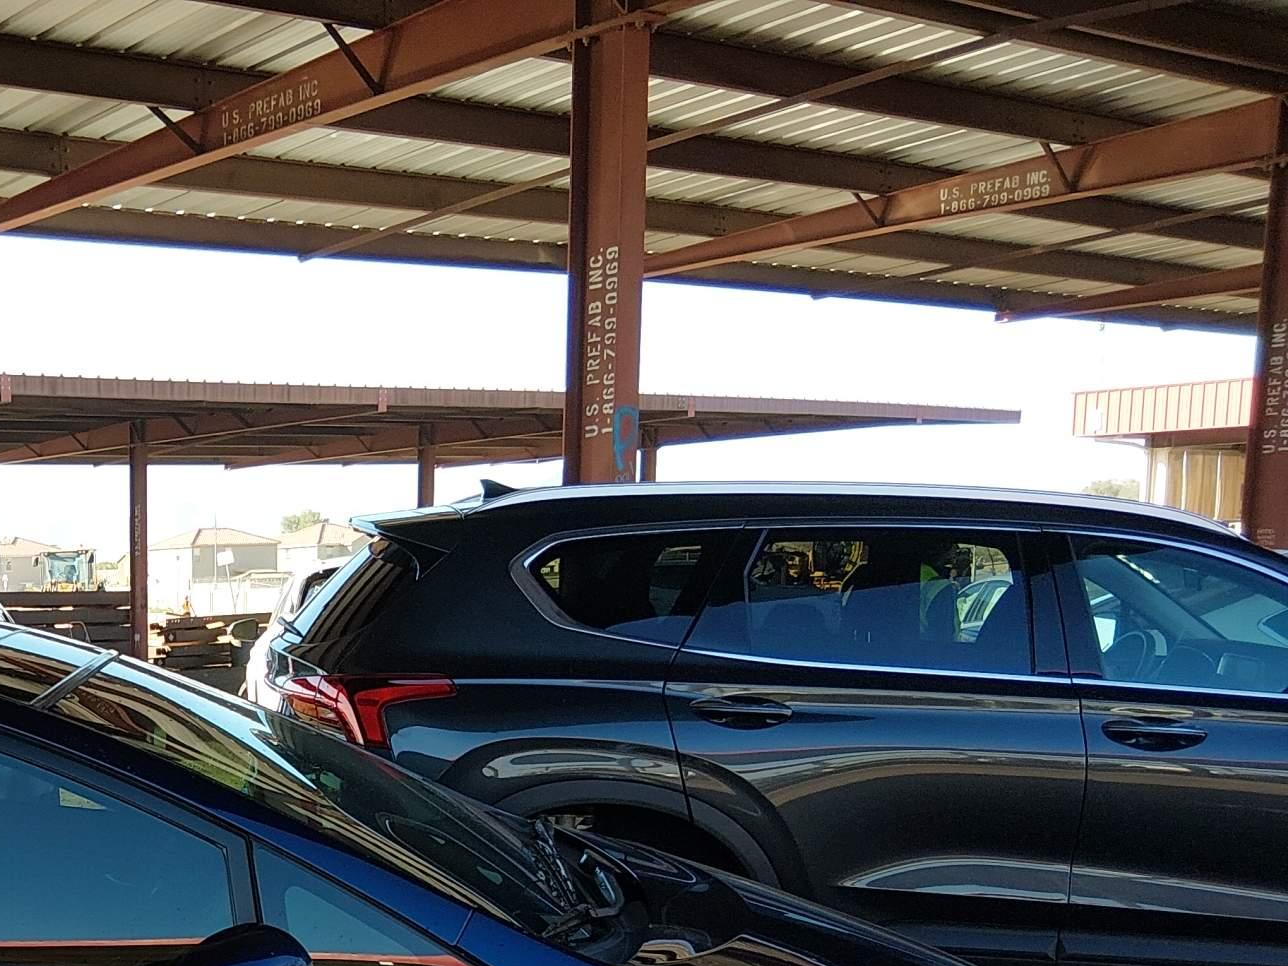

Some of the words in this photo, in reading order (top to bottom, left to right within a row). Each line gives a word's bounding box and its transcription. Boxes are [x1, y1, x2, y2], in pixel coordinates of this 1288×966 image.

[222, 98, 321, 146] 1-866-799-0969
[249, 89, 293, 120] PREFAB
[940, 187, 963, 201] U.S.
[970, 175, 1020, 195] PREFAB
[1026, 170, 1051, 186] INC.
[940, 184, 1050, 214] 1-866-799-0969
[588, 247, 604, 290] INC.
[586, 300, 602, 385] PREFAB
[600, 245, 619, 435] 1-866-799-0969
[1271, 318, 1287, 348] INC.
[1265, 355, 1283, 416] PREFAB
[584, 396, 600, 439] U.S.
[1262, 425, 1277, 454] U.S.
